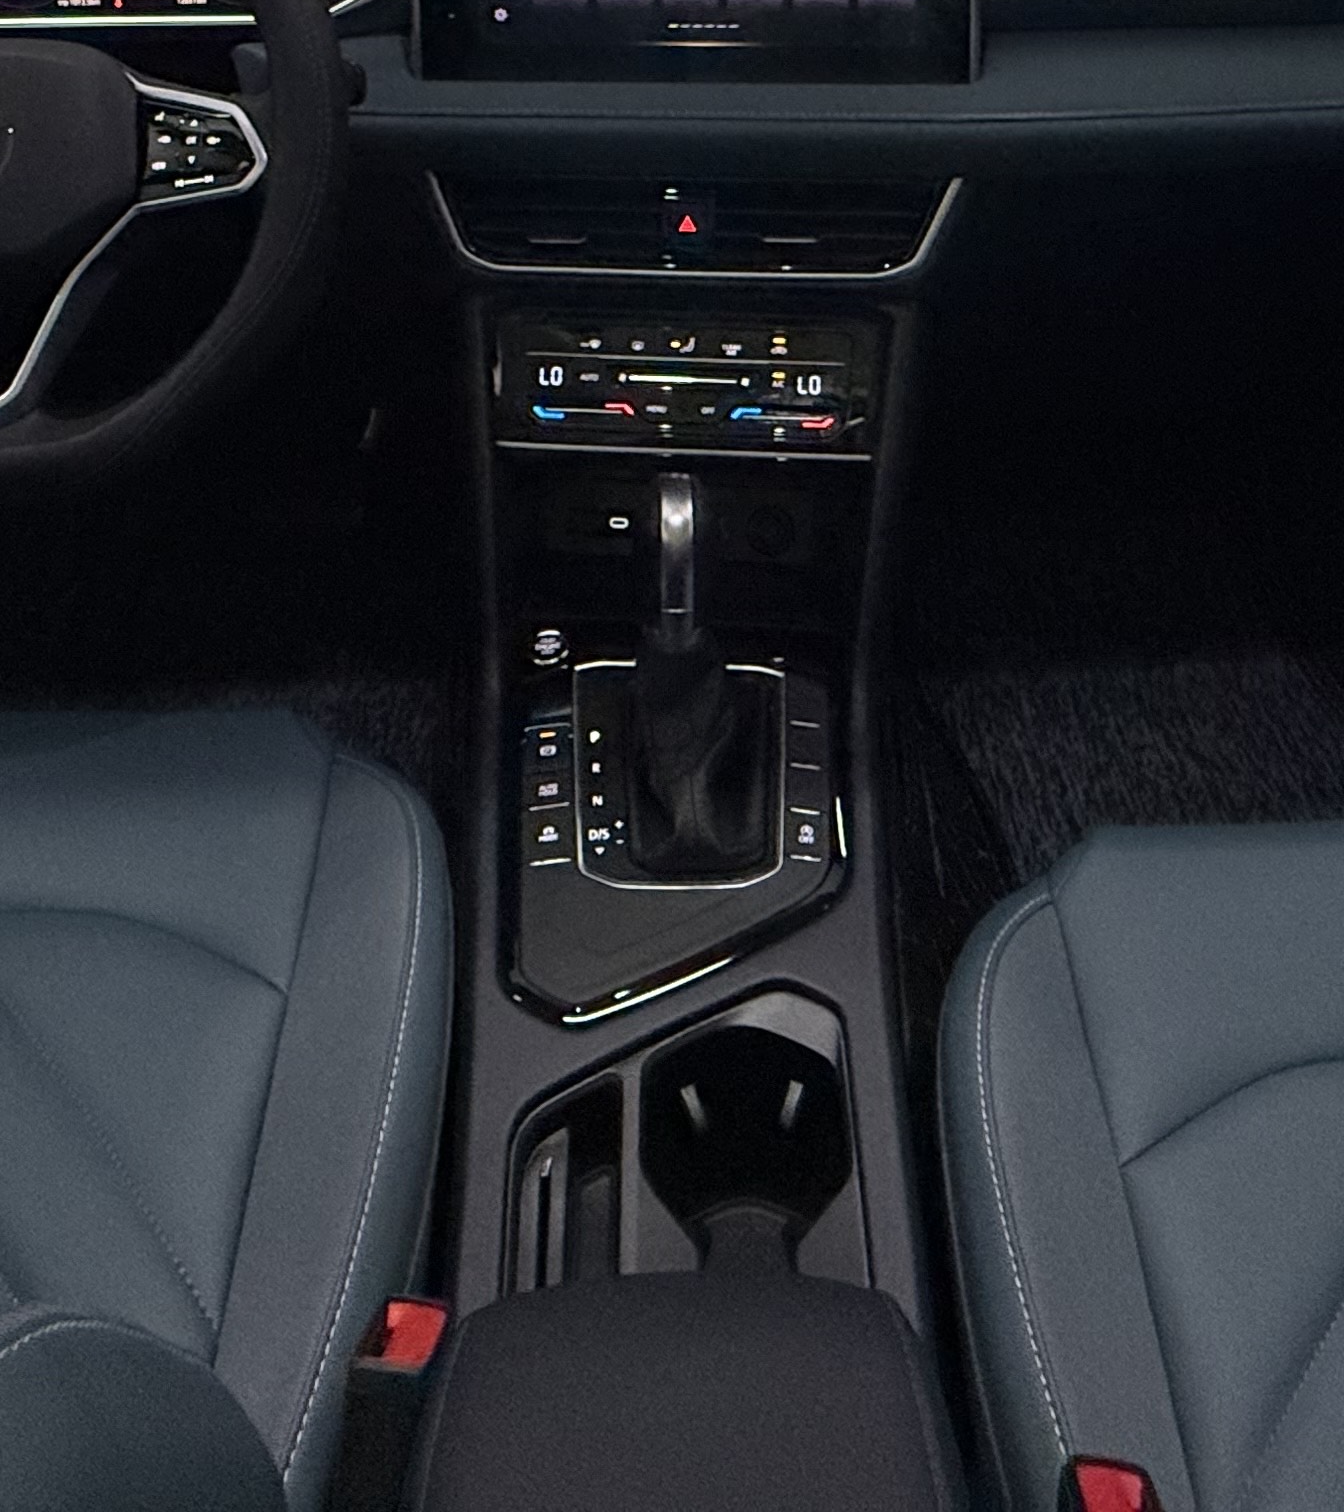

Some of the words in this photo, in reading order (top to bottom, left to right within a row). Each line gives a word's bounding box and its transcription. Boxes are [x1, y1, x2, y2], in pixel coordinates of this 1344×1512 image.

[539, 366, 563, 386] LO
[797, 375, 822, 396] LO
[592, 762, 601, 774] R
[592, 795, 603, 807] N
[588, 827, 611, 842] D/S
